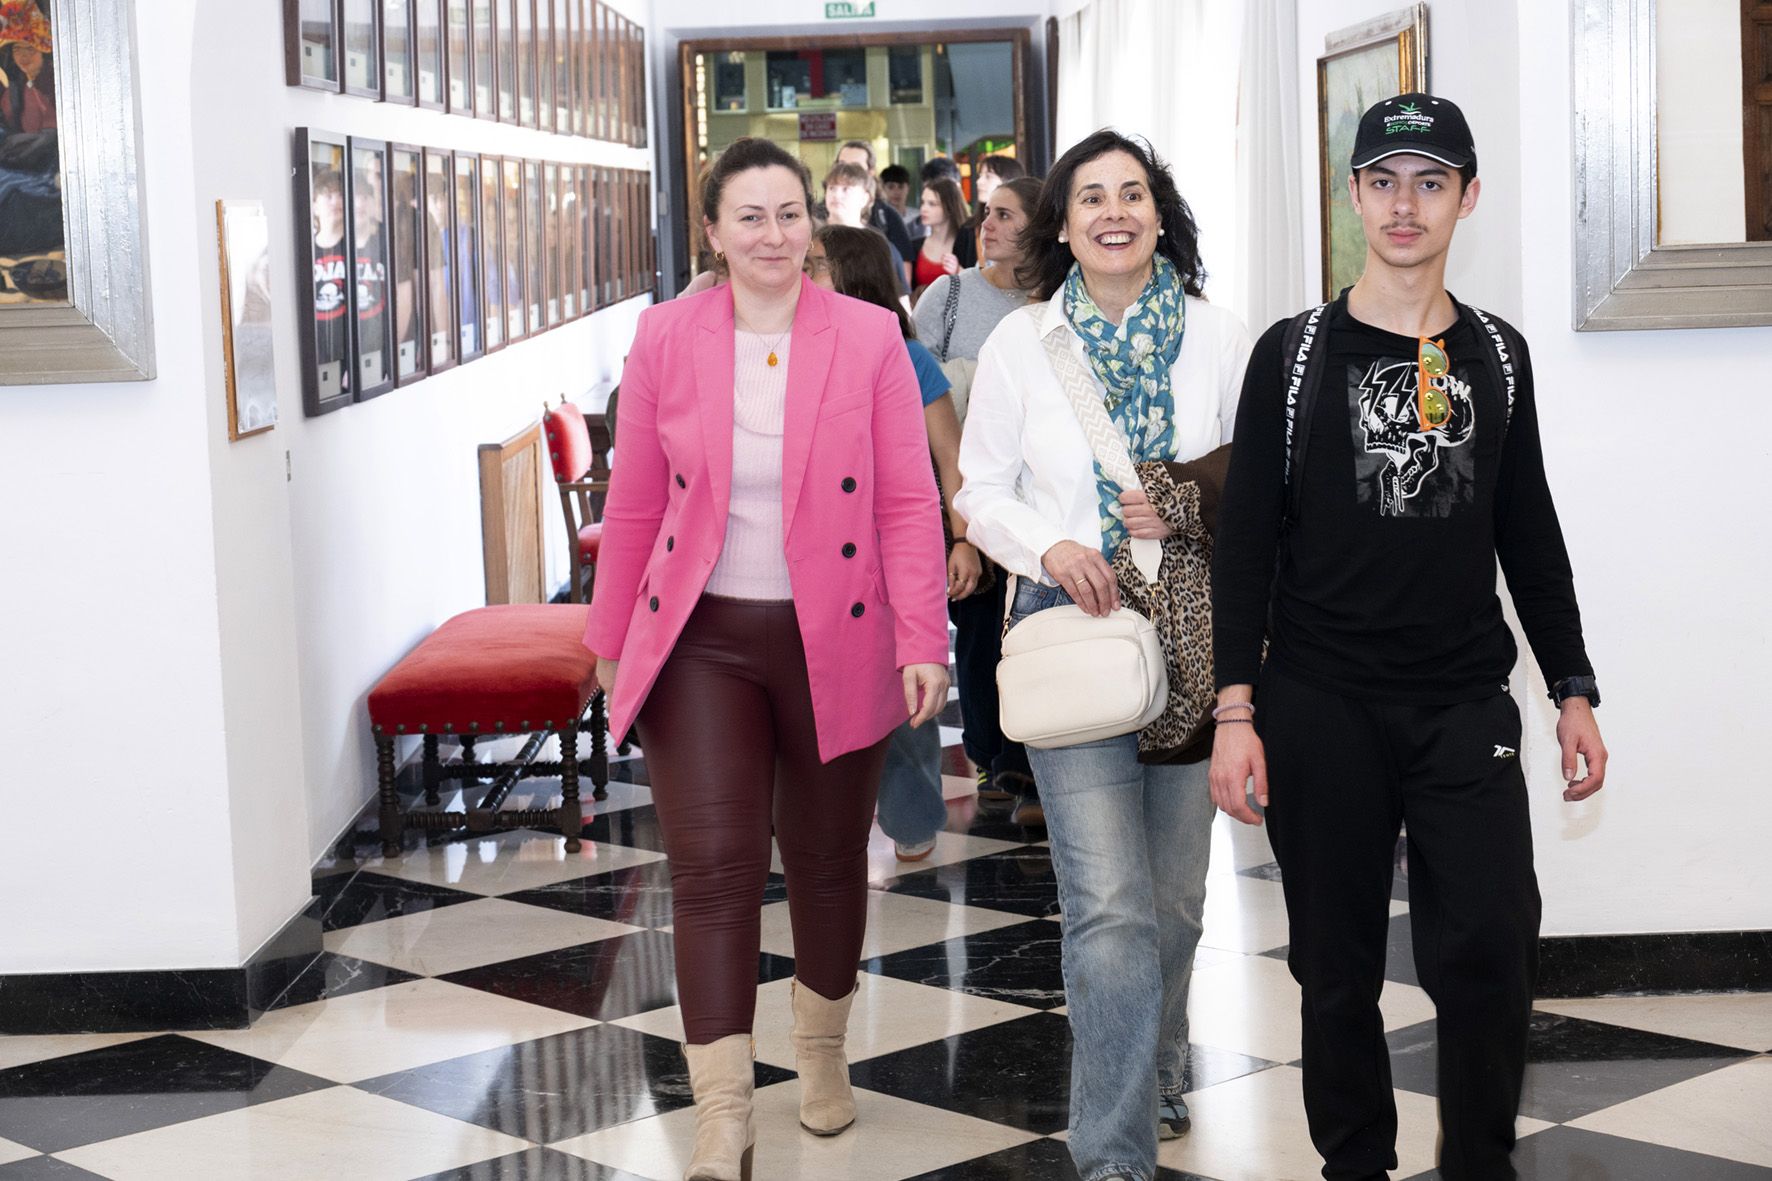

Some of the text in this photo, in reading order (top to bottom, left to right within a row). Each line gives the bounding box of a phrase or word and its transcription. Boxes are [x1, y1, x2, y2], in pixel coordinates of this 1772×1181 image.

[1384, 114, 1434, 123] Extremadura
[1385, 124, 1431, 135] STAFF
[1296, 334, 1314, 362] FILA
[1491, 333, 1509, 363] FILA
[1505, 375, 1515, 406] FILA
[1286, 376, 1302, 406] FILA
[1285, 418, 1294, 446] FILA
